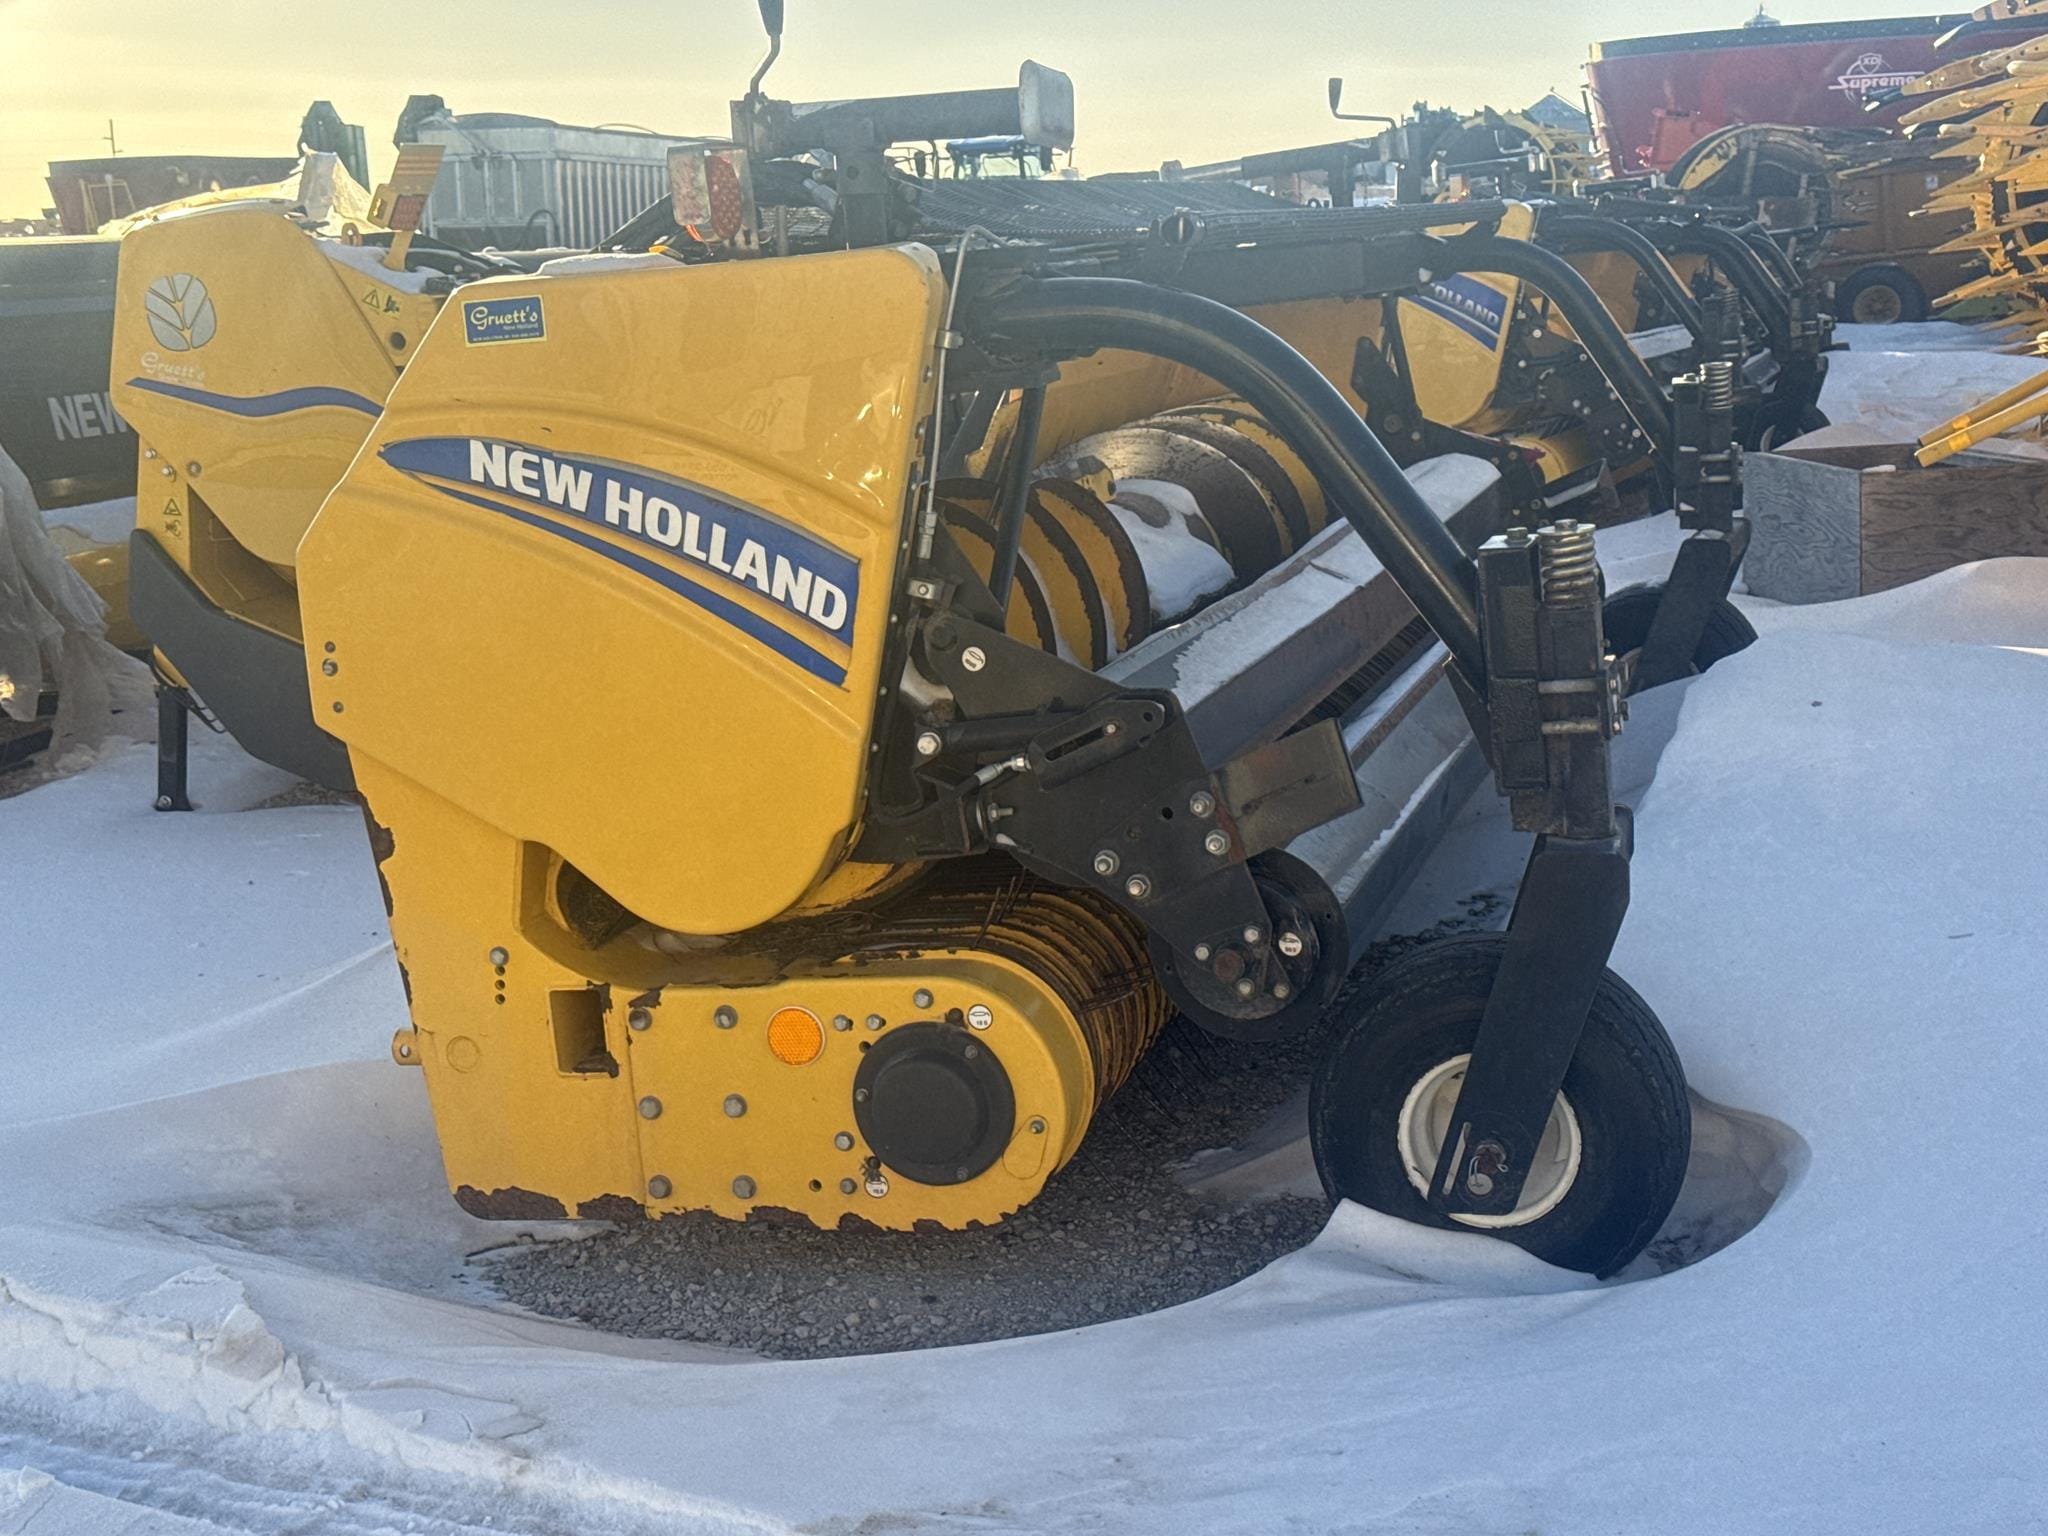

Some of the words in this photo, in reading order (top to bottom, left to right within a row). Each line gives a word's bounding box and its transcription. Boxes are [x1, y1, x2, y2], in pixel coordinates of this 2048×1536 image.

[471, 305, 538, 330] Gruett's
[1430, 282, 1499, 325] OLLAND
[469, 439, 593, 513] NEW
[604, 478, 848, 631] HOLLAND
